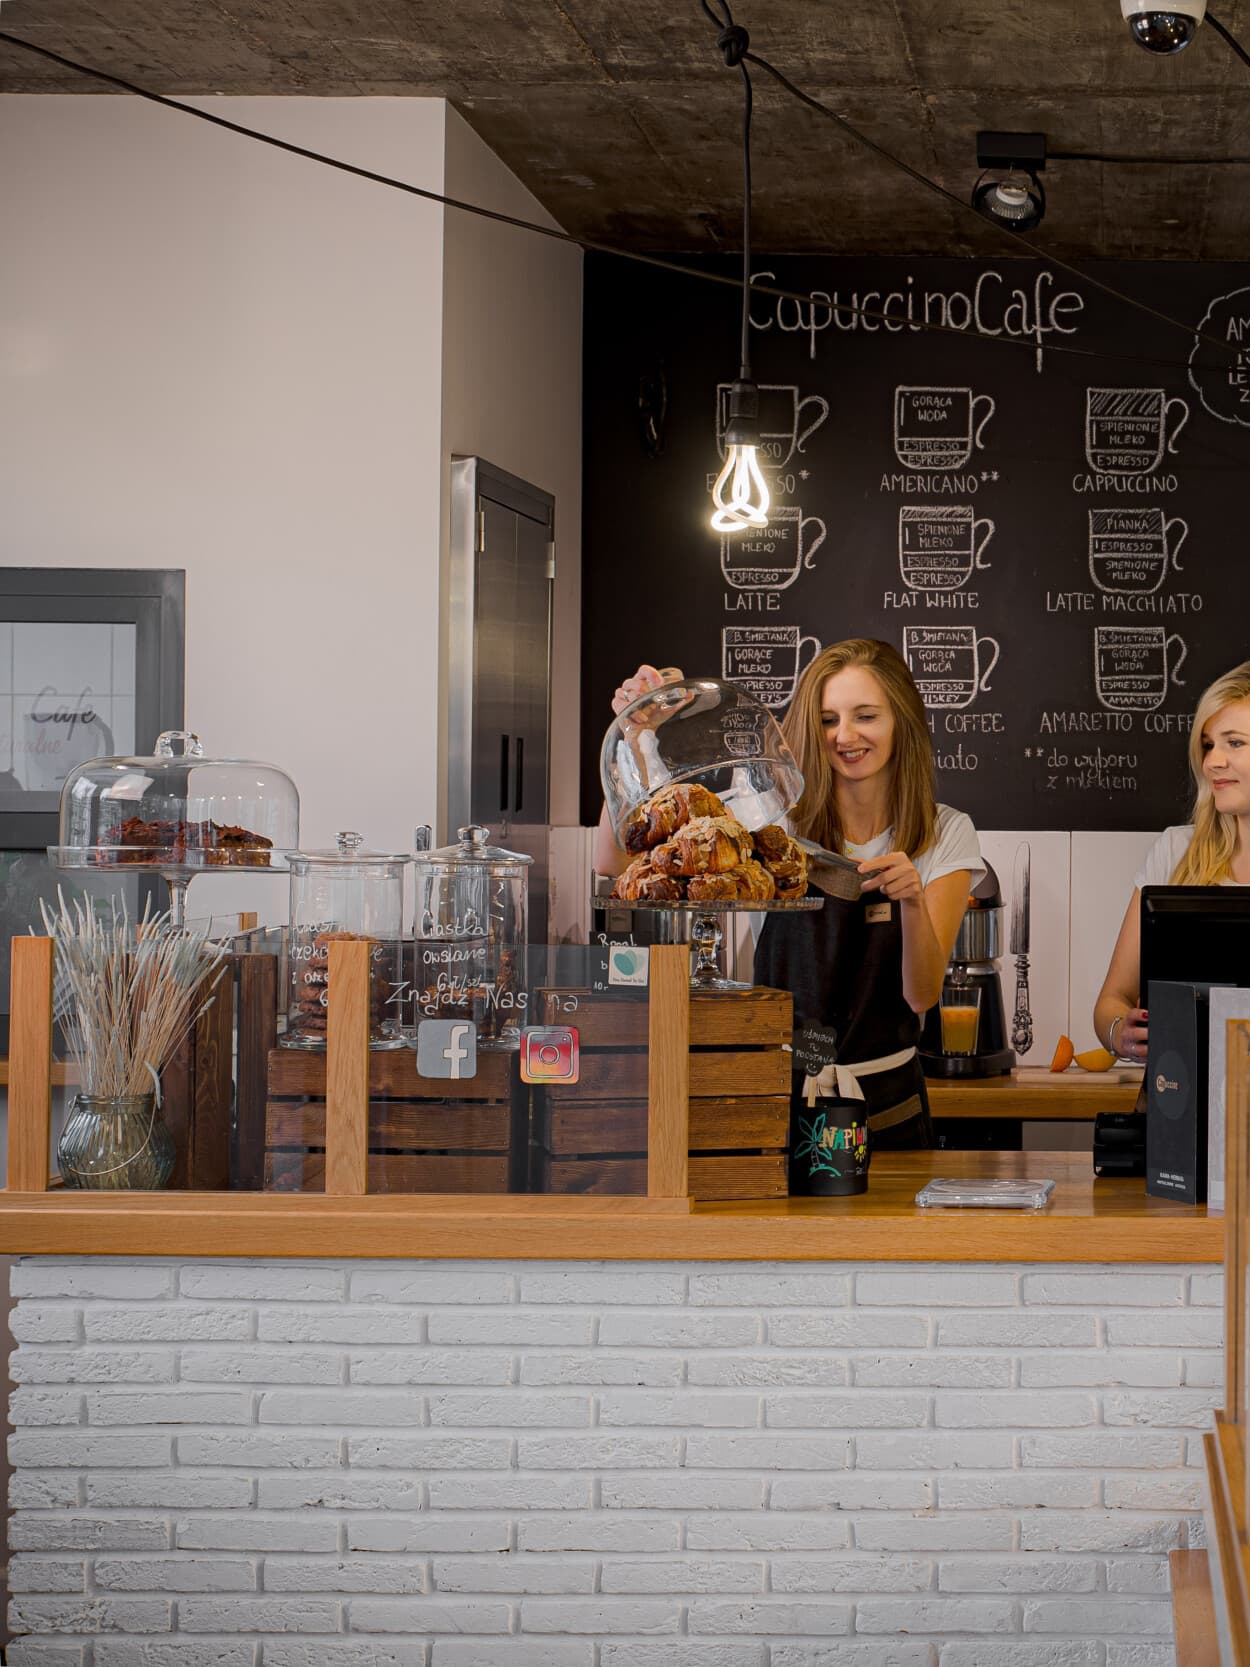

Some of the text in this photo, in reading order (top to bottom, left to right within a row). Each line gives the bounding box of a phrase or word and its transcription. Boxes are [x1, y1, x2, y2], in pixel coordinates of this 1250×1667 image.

[912, 396, 953, 408] GORĄCA
[918, 409, 948, 422] WODA
[903, 440, 961, 452] ESPRESSO
[1109, 434, 1146, 446] MLEKO
[908, 454, 961, 466] ESPRESSO
[1097, 455, 1150, 467] ESPRESSO
[1072, 474, 1178, 493] CAPPUCCINO
[1106, 518, 1149, 530] PIANKA
[741, 542, 776, 553] MLEKO
[919, 537, 954, 548] MLEKO
[1101, 541, 1153, 551] ESPRESSO
[907, 556, 960, 567] ESPRESSO
[731, 571, 780, 583] ESPRESSO
[910, 572, 962, 585] ESPRESSO
[724, 592, 781, 611] LATTE
[884, 591, 980, 609] FLAT WHITE
[1046, 591, 1203, 614] LATTE MACCHIATO
[734, 648, 775, 662] GORĄCE
[738, 663, 772, 674] MLEKO
[1102, 681, 1150, 690] ESPRESSO
[30, 685, 97, 741] Cafe
[945, 713, 1005, 733] COFFEE
[1039, 711, 1196, 734] AMARETTO COFFE
[1074, 745, 1137, 778] wyboru
[1046, 775, 1058, 789] z
[422, 908, 486, 939] Ciastka
[422, 948, 486, 965] owsiane
[384, 980, 578, 1016] Znajdź Nas na
